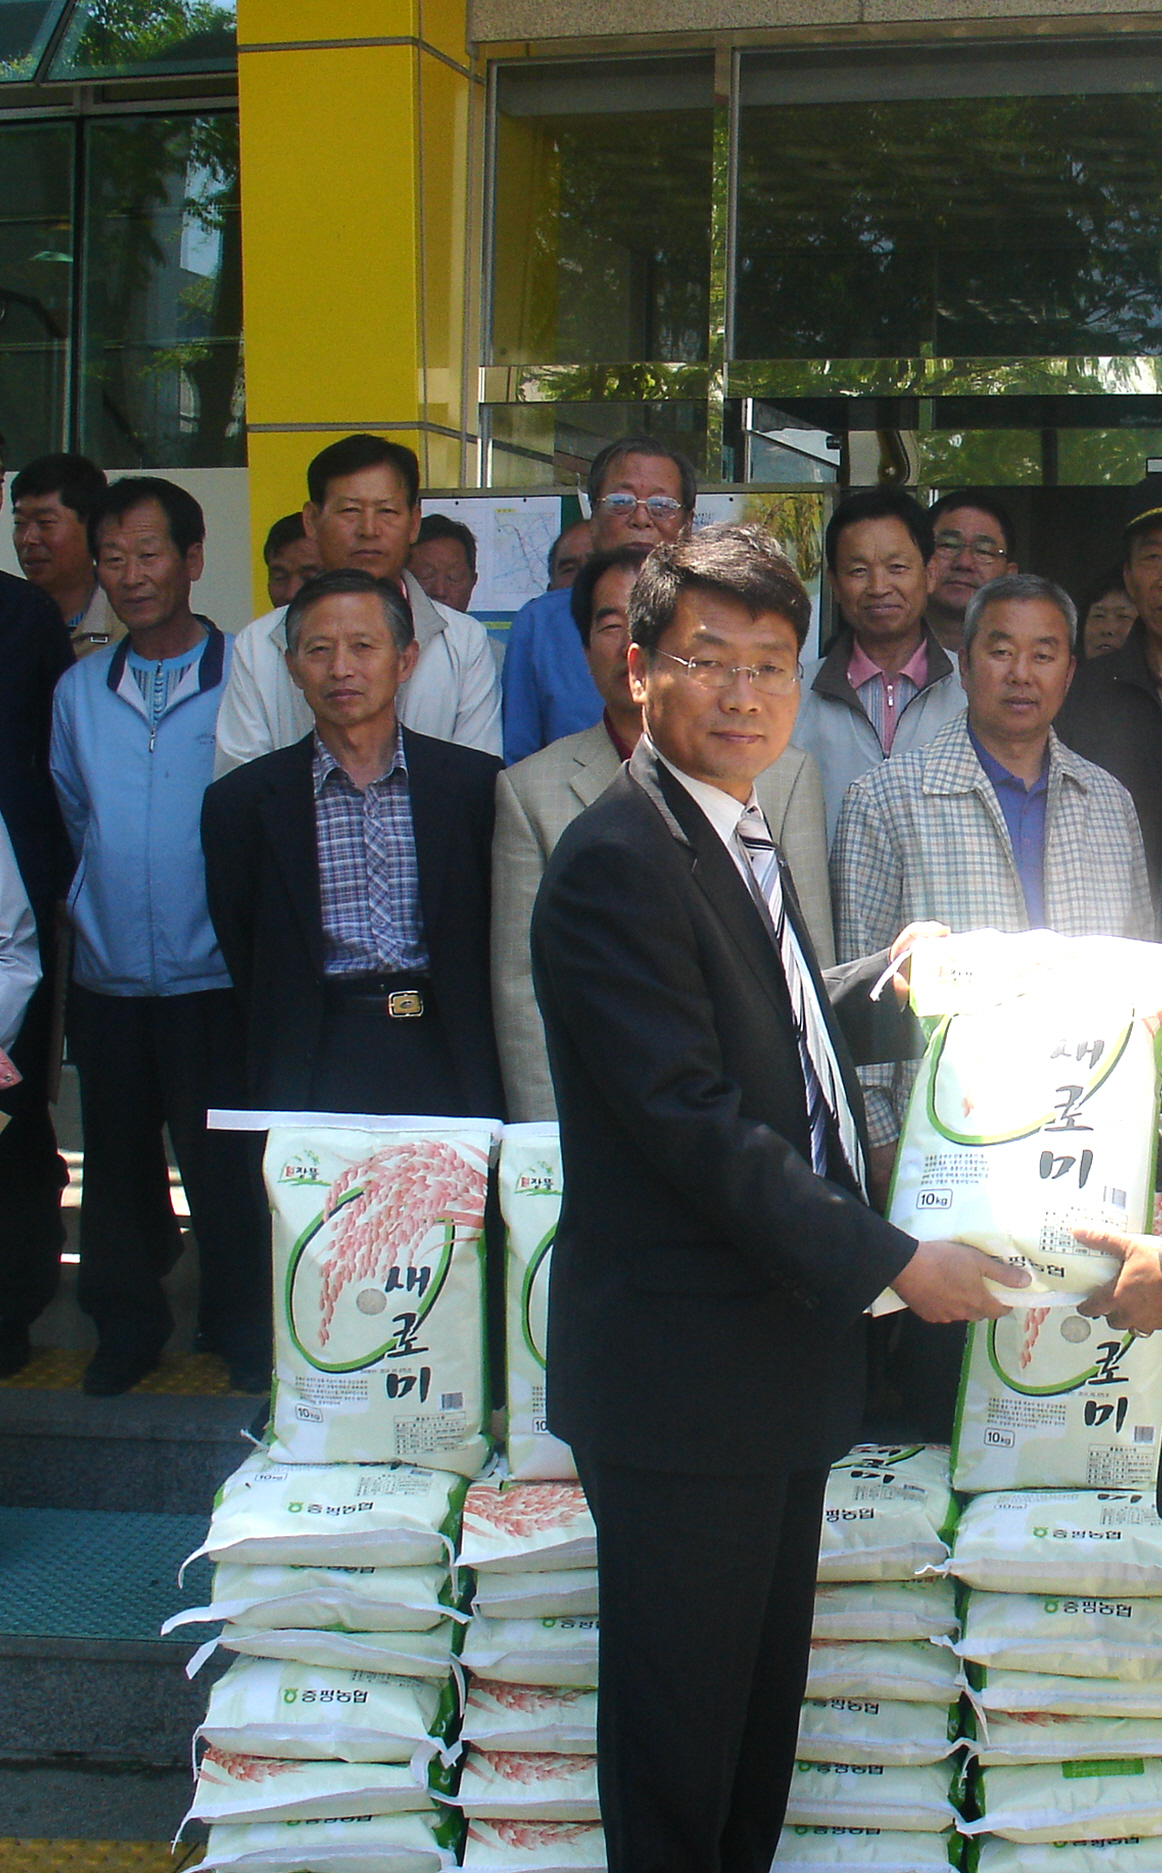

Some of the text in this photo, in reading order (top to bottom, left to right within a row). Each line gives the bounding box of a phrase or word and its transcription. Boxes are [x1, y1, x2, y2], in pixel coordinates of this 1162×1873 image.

[920, 1192, 948, 1206] 10kg
[298, 1407, 321, 1421] 10kg
[535, 1420, 548, 1431] 10
[987, 1431, 1012, 1445] 10kg
[826, 1508, 875, 1523] 평농협
[301, 1688, 368, 1704] 증평농협
